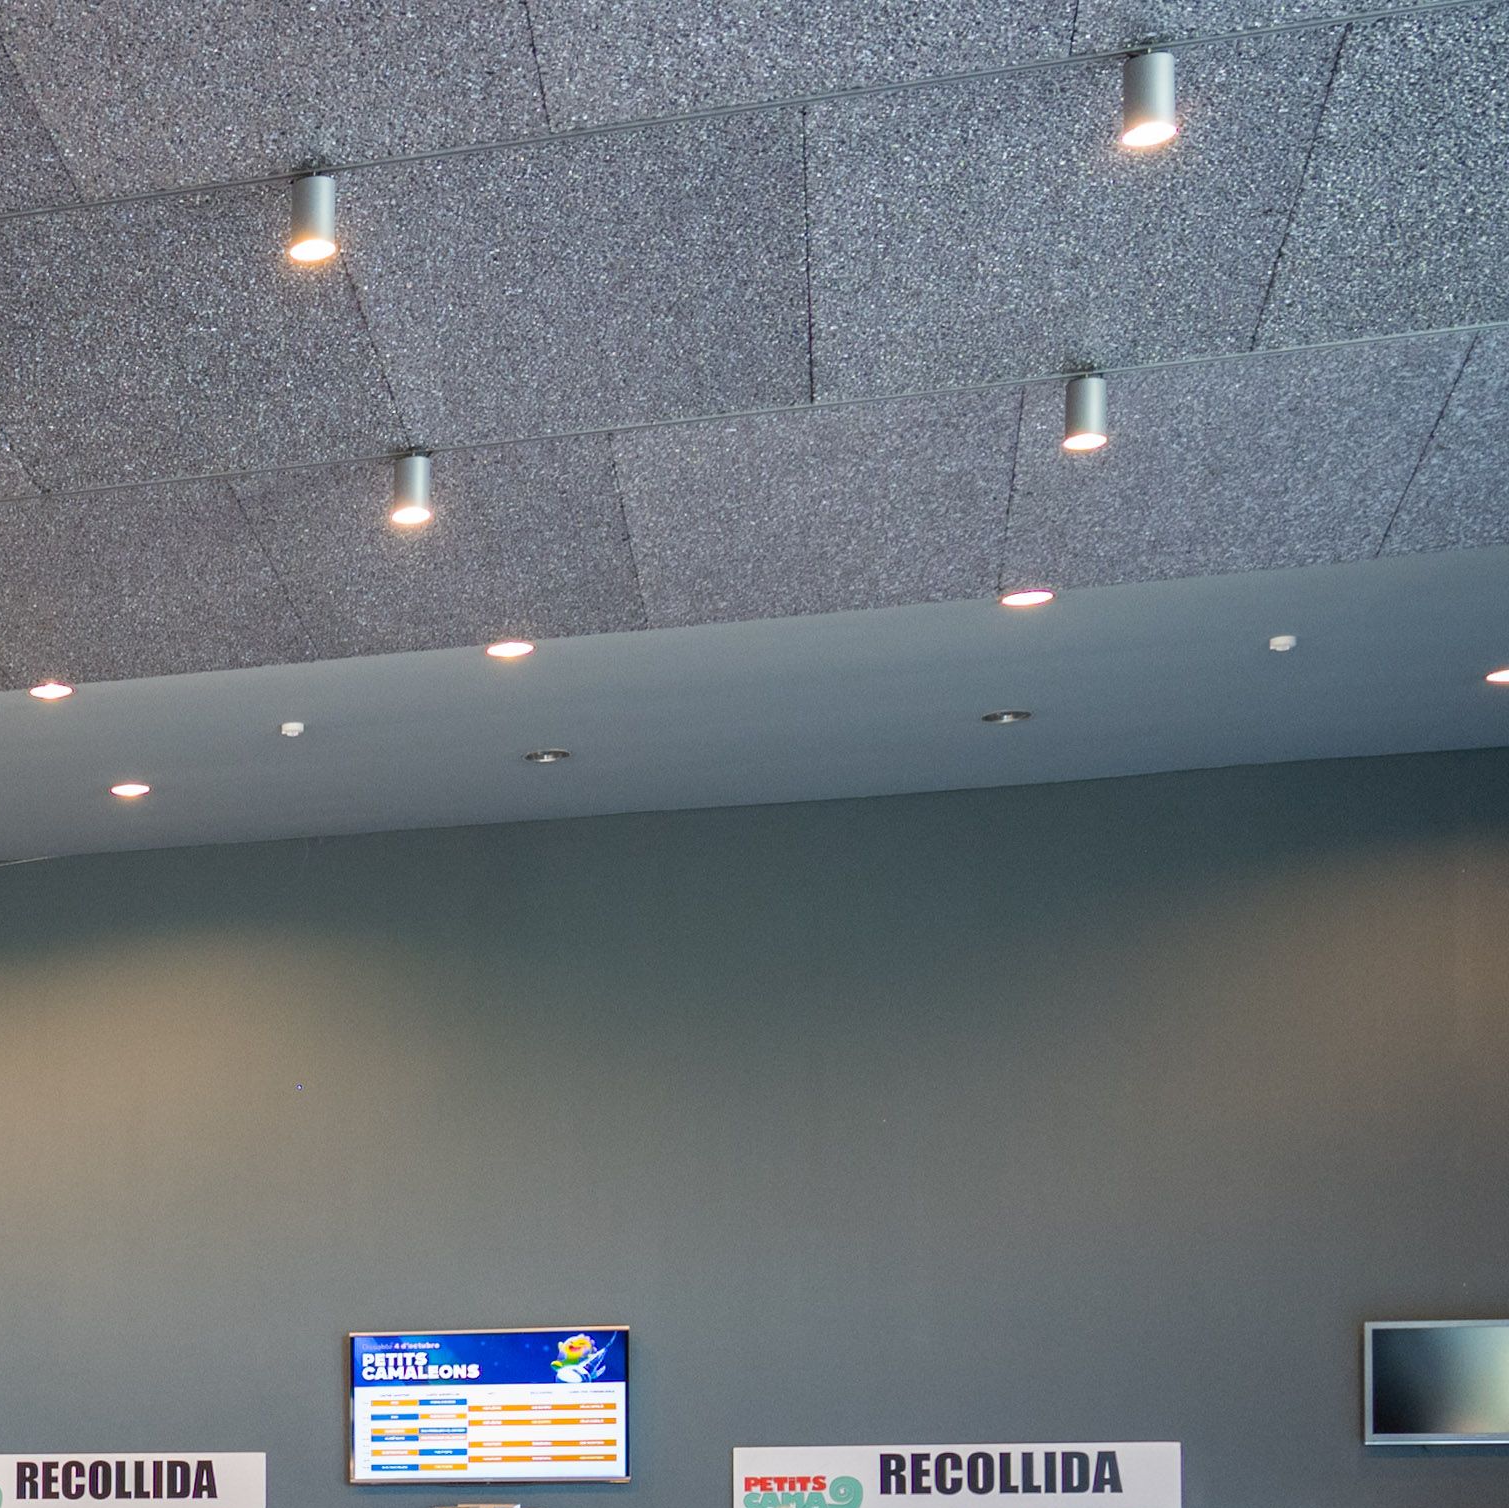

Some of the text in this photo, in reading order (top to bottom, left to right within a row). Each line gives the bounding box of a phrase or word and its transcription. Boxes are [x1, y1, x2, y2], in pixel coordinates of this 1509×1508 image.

[362, 1352, 428, 1367] PETITS
[362, 1364, 480, 1380] CAMALEONS
[16, 1460, 218, 1500] RECOLLIDA
[880, 1451, 1123, 1495] RECOLLIDA
